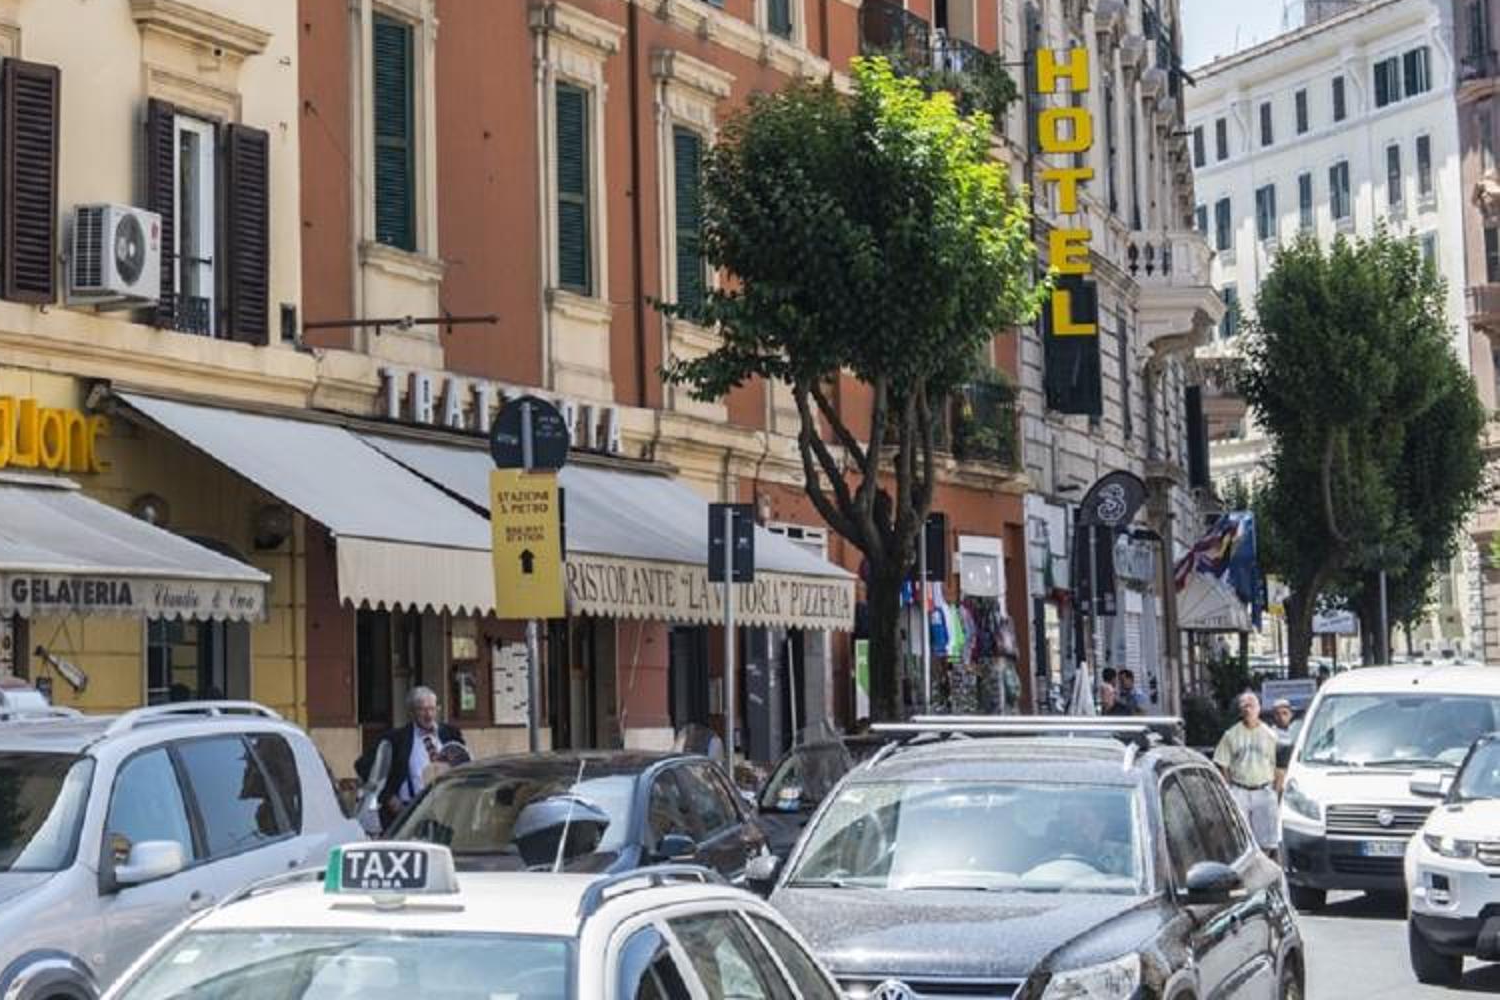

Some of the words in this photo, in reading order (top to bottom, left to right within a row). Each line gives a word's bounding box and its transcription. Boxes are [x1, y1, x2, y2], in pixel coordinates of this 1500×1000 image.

[1036, 46, 1097, 336] HOTEL
[378, 366, 622, 453] TRATRIA
[11, 578, 133, 606] GELATERIA
[565, 561, 676, 608] RISTORANTE
[790, 580, 851, 619] PIZZERIA
[346, 851, 422, 879] TAXI
